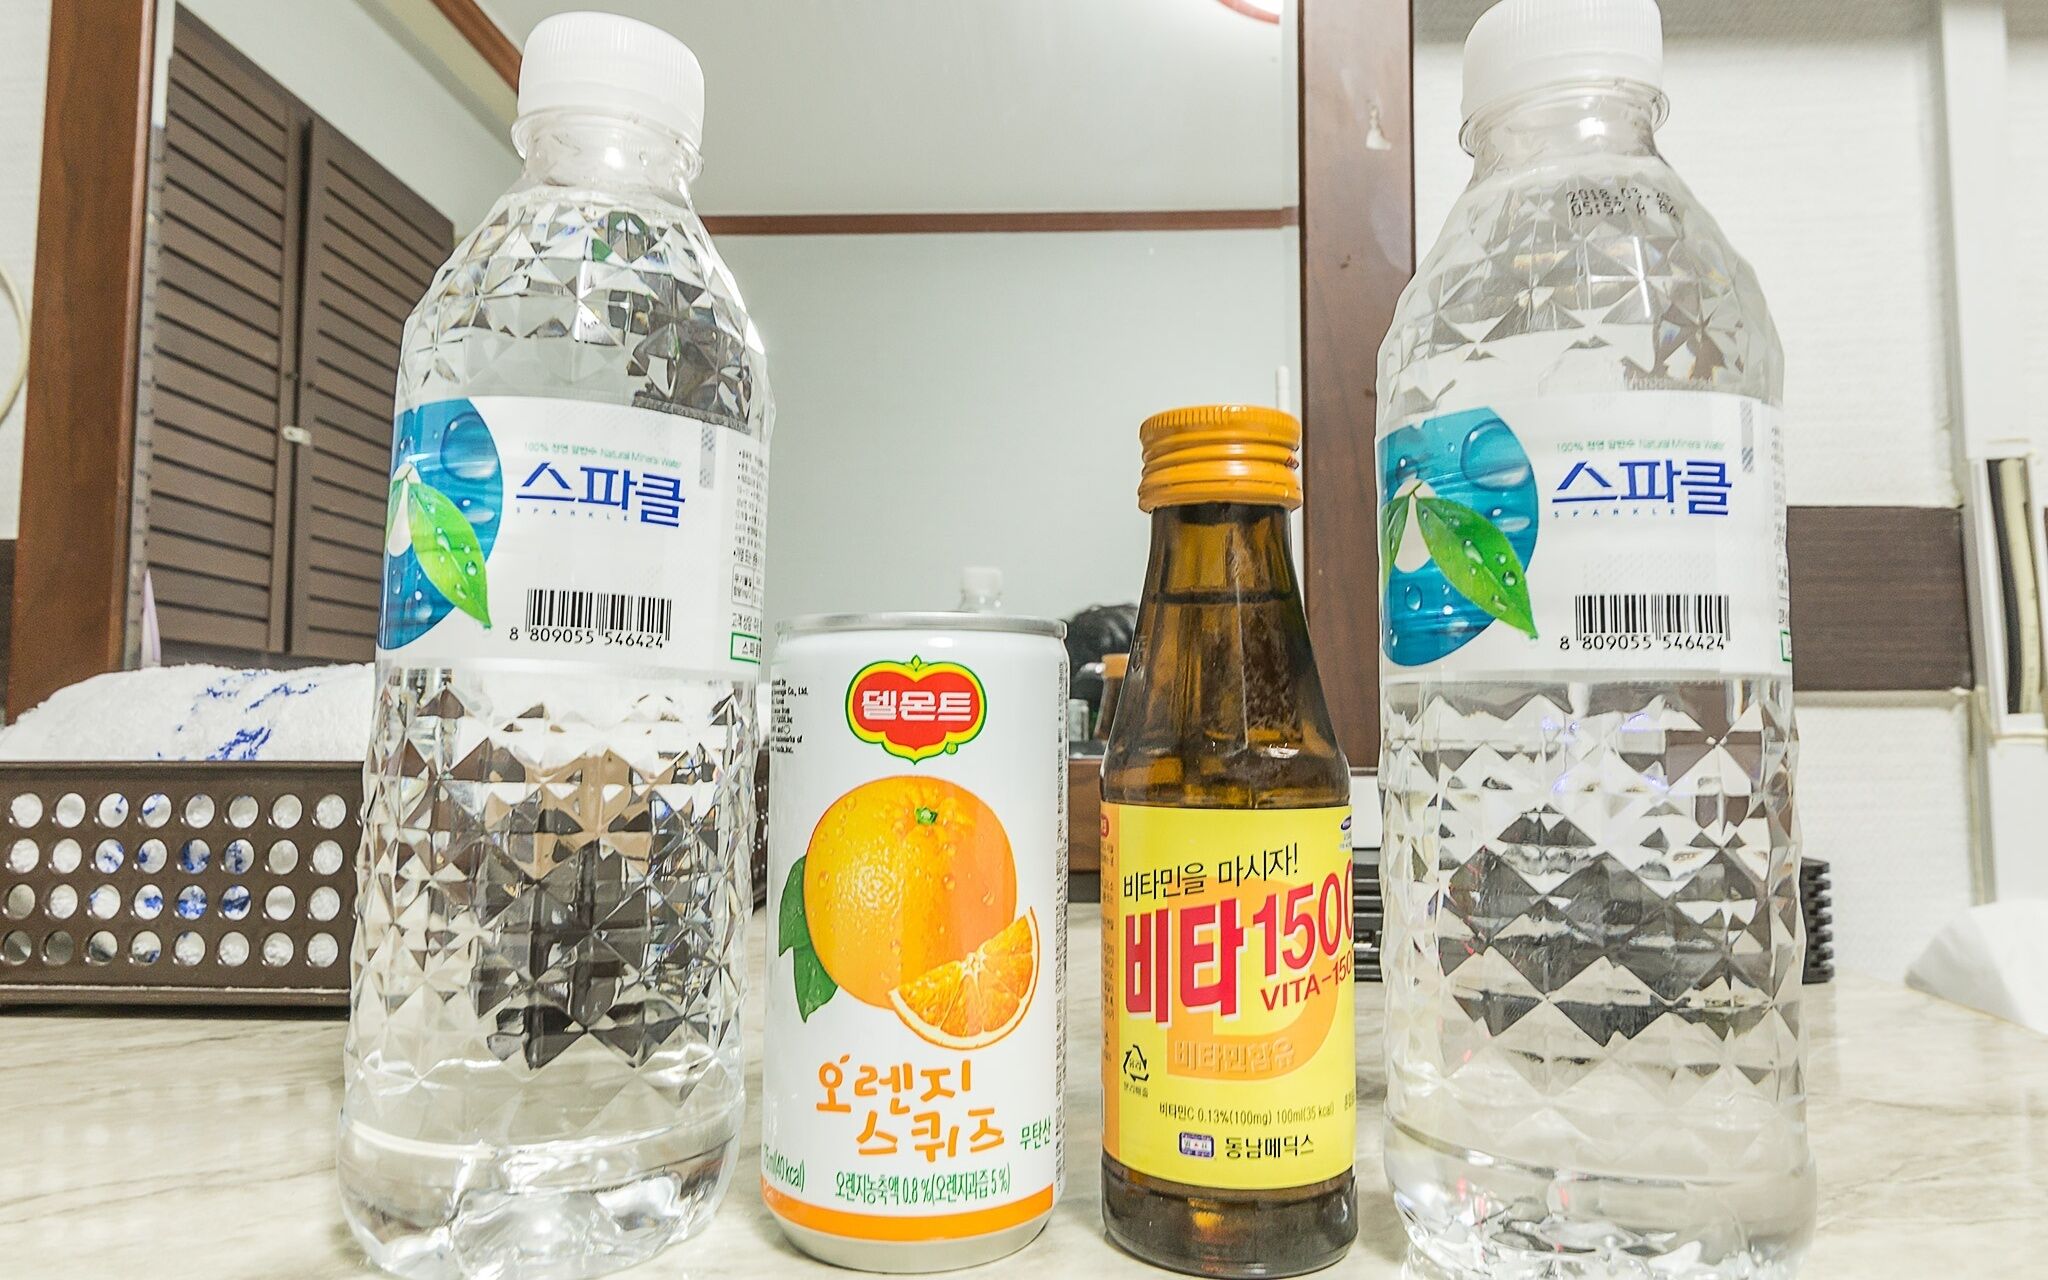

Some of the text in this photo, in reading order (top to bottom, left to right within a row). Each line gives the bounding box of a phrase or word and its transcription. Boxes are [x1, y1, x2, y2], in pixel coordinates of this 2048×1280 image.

[600, 447, 630, 461] Natural
[516, 461, 686, 528] 스파클
[1552, 459, 1733, 516] 스파클
[516, 507, 629, 522] SPARKLE
[1554, 507, 1676, 519] SPARKLE
[509, 627, 664, 649] 8 809055 546424
[1560, 635, 1725, 651] 8 809055 546424
[862, 689, 973, 722] 델몬트
[1123, 842, 1299, 902] 비타민을 마시자!
[1173, 1036, 1296, 1073] 비타민함유
[815, 1053, 973, 1116] 오렌지
[1019, 1115, 1052, 1152] 무탄산
[1197, 1108, 1272, 1127] 0.13%(100mg)
[856, 1107, 1005, 1163] 스퀴즈
[1224, 1133, 1315, 1160] 동남메딕스
[834, 1170, 899, 1206] 오렌지농축액
